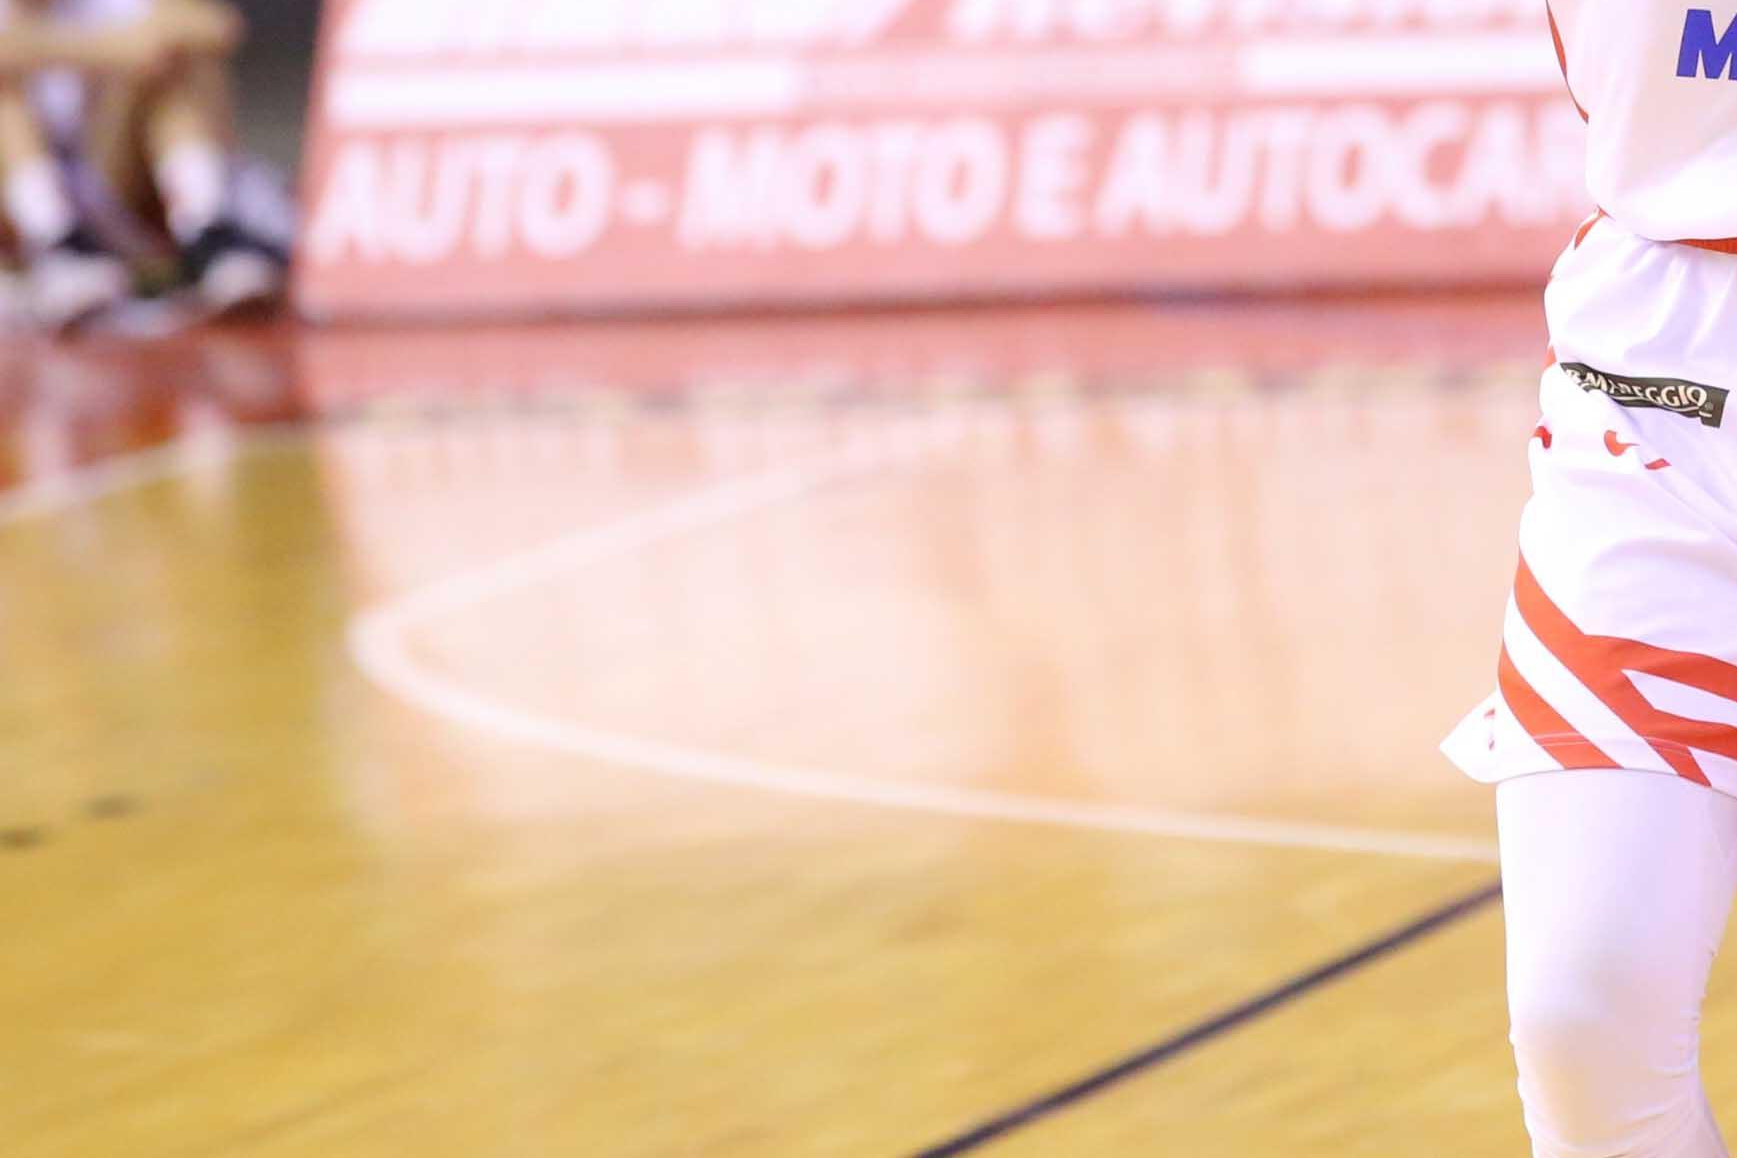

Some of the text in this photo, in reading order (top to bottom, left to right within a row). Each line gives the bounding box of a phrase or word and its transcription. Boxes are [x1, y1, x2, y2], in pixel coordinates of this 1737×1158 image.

[306, 128, 613, 265] AUTO
[679, 118, 1006, 252] MOTO
[1016, 108, 1090, 238] E
